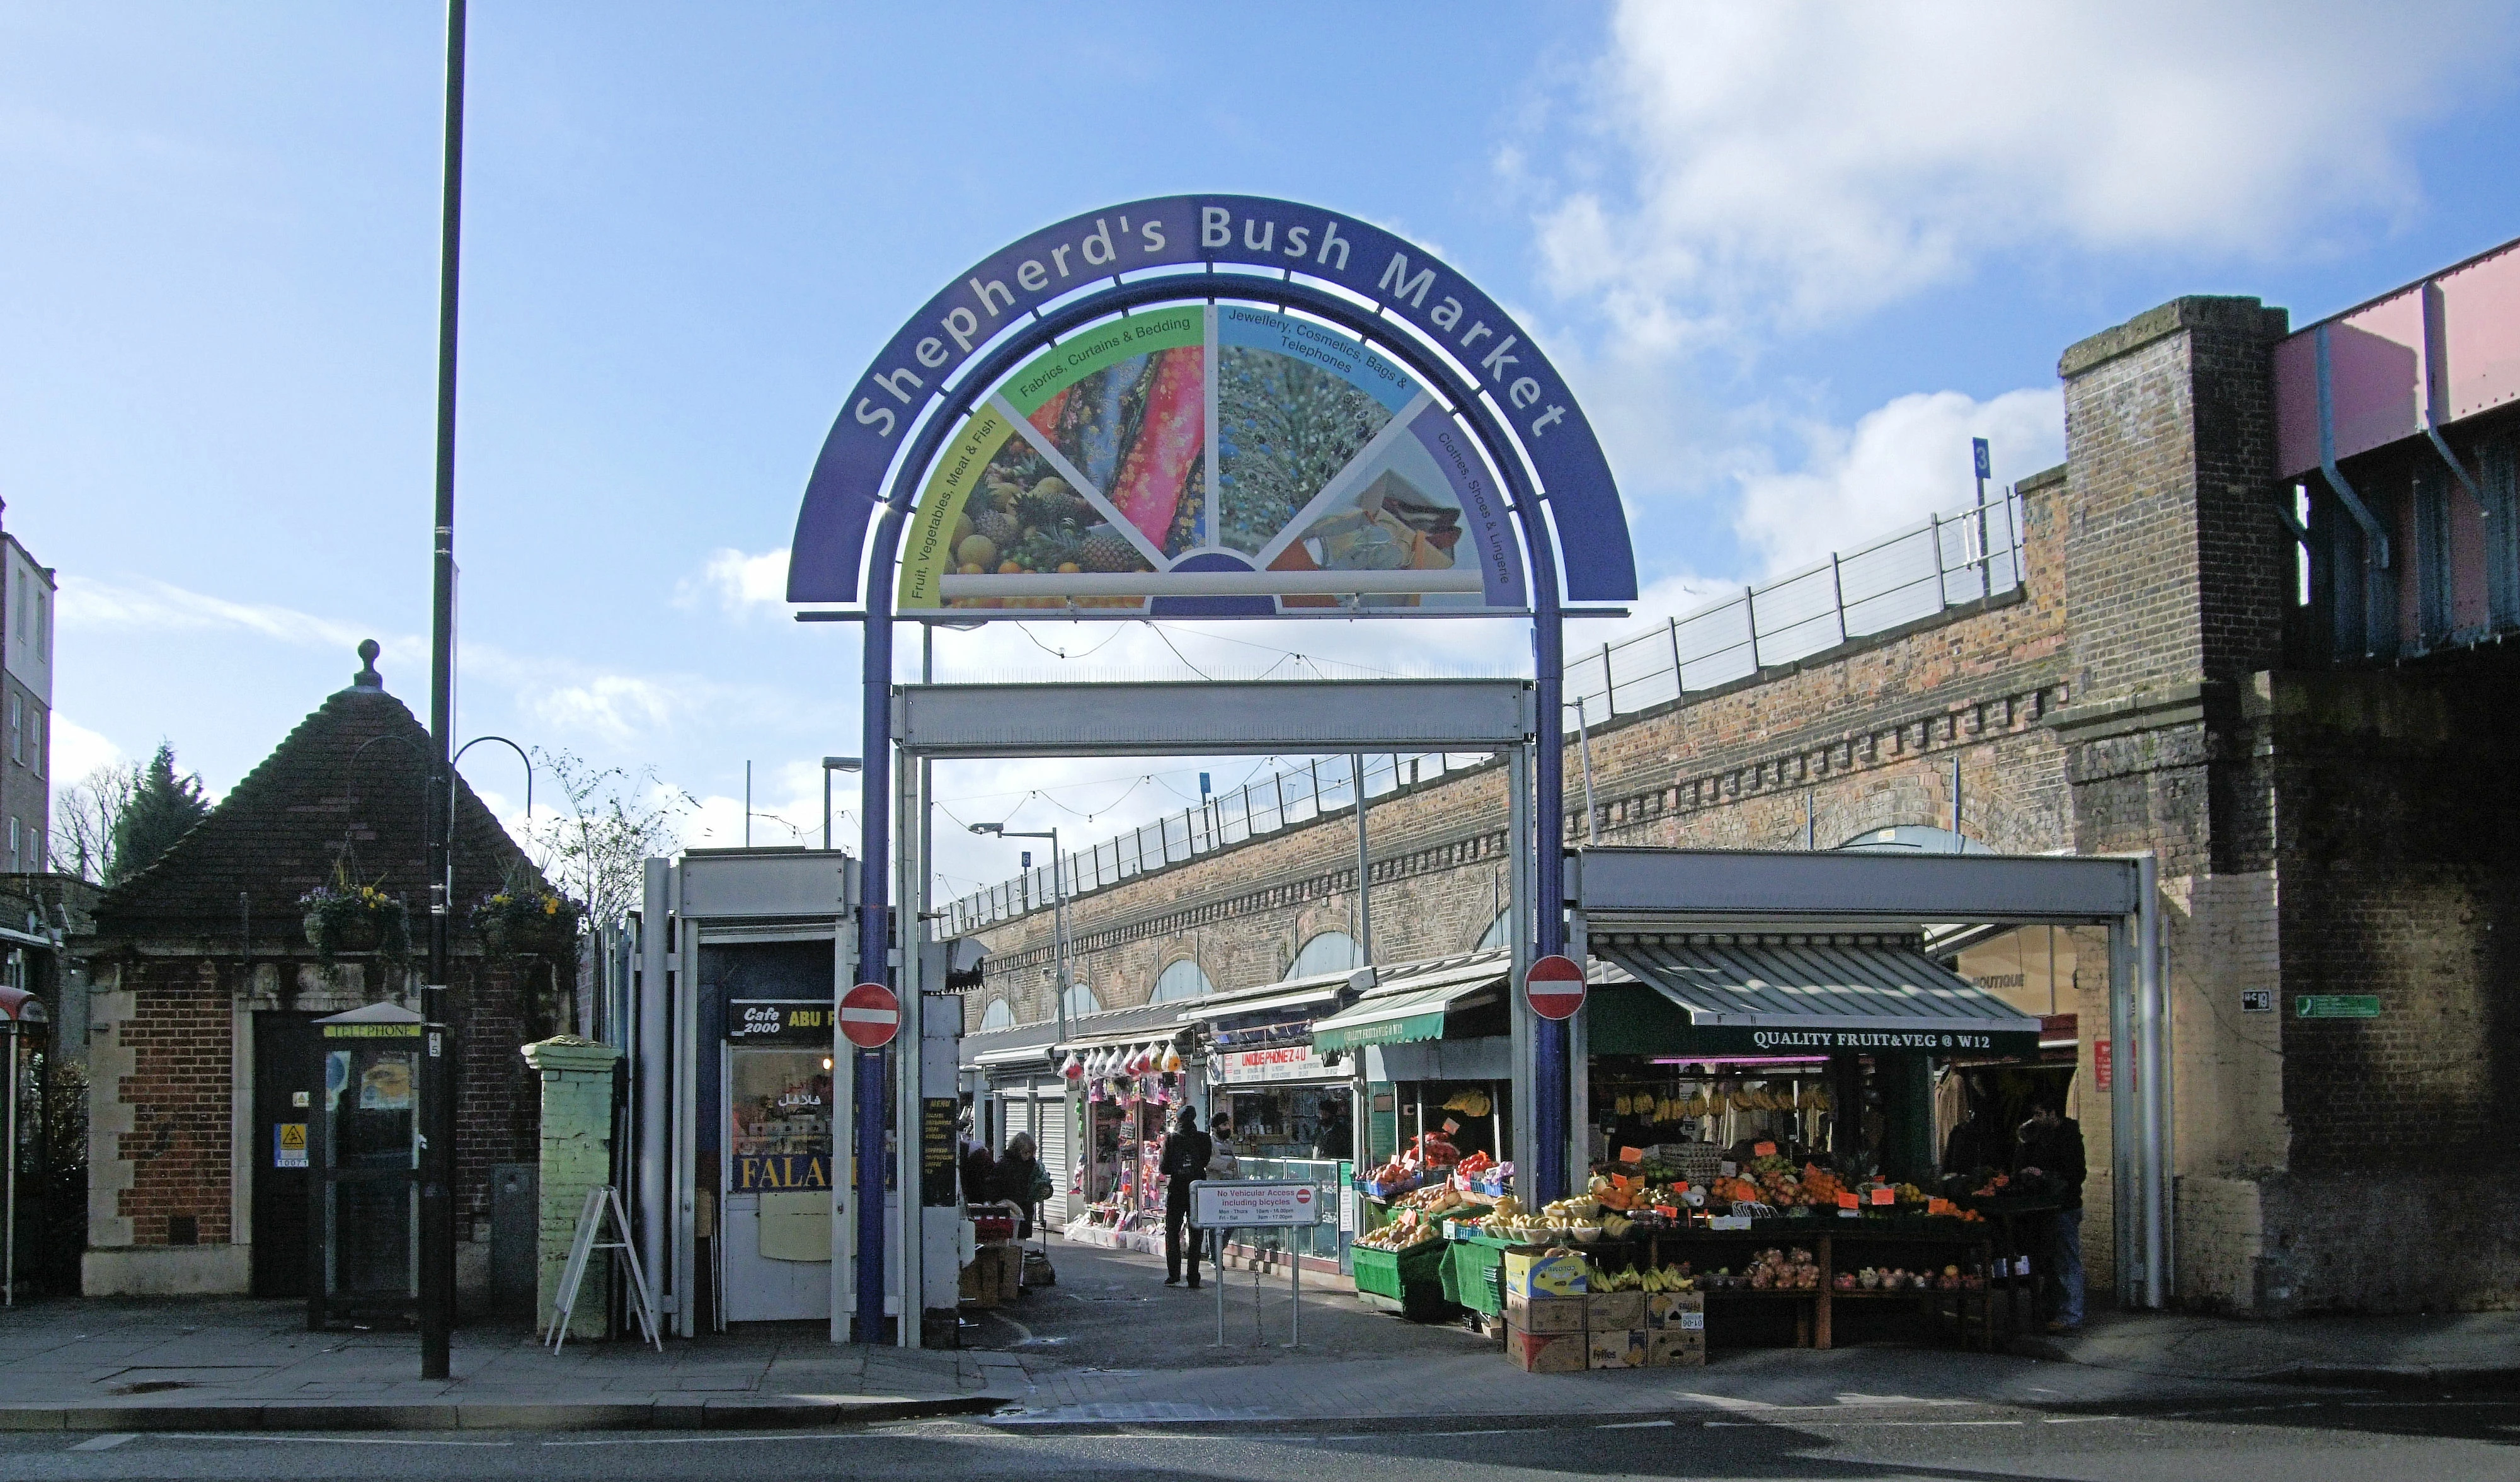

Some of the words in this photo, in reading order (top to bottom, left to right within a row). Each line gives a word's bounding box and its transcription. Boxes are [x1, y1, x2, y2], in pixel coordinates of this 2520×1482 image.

[856, 216, 1166, 437] Shepherd's
[1201, 206, 1351, 270] Bush
[1378, 252, 1566, 437] Market
[1019, 364, 1068, 398] Fabrics,
[1068, 336, 1121, 367] Curtains
[1123, 331, 1134, 342] &
[1135, 318, 1191, 339] Bedding
[1228, 309, 1292, 333] Jewellery,
[1297, 324, 1362, 363] Cosmetics,
[1365, 356, 1396, 382] Bags
[1397, 377, 1407, 389] &
[1281, 335, 1353, 374] Telephones
[972, 418, 997, 444] Fish
[965, 444, 977, 456] &
[1976, 445, 1988, 469] 3
[946, 456, 971, 486] Meat
[1468, 480, 1491, 519] Shoes
[917, 490, 954, 563] Vegetables,
[1486, 521, 1497, 531] &
[1490, 534, 1509, 584] Lingerie
[912, 566, 929, 599] Fruit,
[743, 1006, 780, 1022] Cafe
[788, 1011, 821, 1027] ABU
[743, 1023, 781, 1033] 2000
[334, 1025, 411, 1037] TELEPHONE
[1753, 1031, 1831, 1049] QUALITY
[1836, 1032, 1937, 1047] FRUIT&VEG
[1942, 1034, 1952, 1047] @
[1957, 1035, 1991, 1048] W12
[1242, 1052, 1264, 1066] UNIQUE
[1295, 1047, 1300, 1061] 4
[1300, 1046, 1306, 1061] U
[778, 1093, 822, 1107] فلافل
[1222, 1198, 1257, 1207] including
[1259, 1198, 1290, 1207] bicycles
[1230, 1189, 1265, 1197] Vehicular
